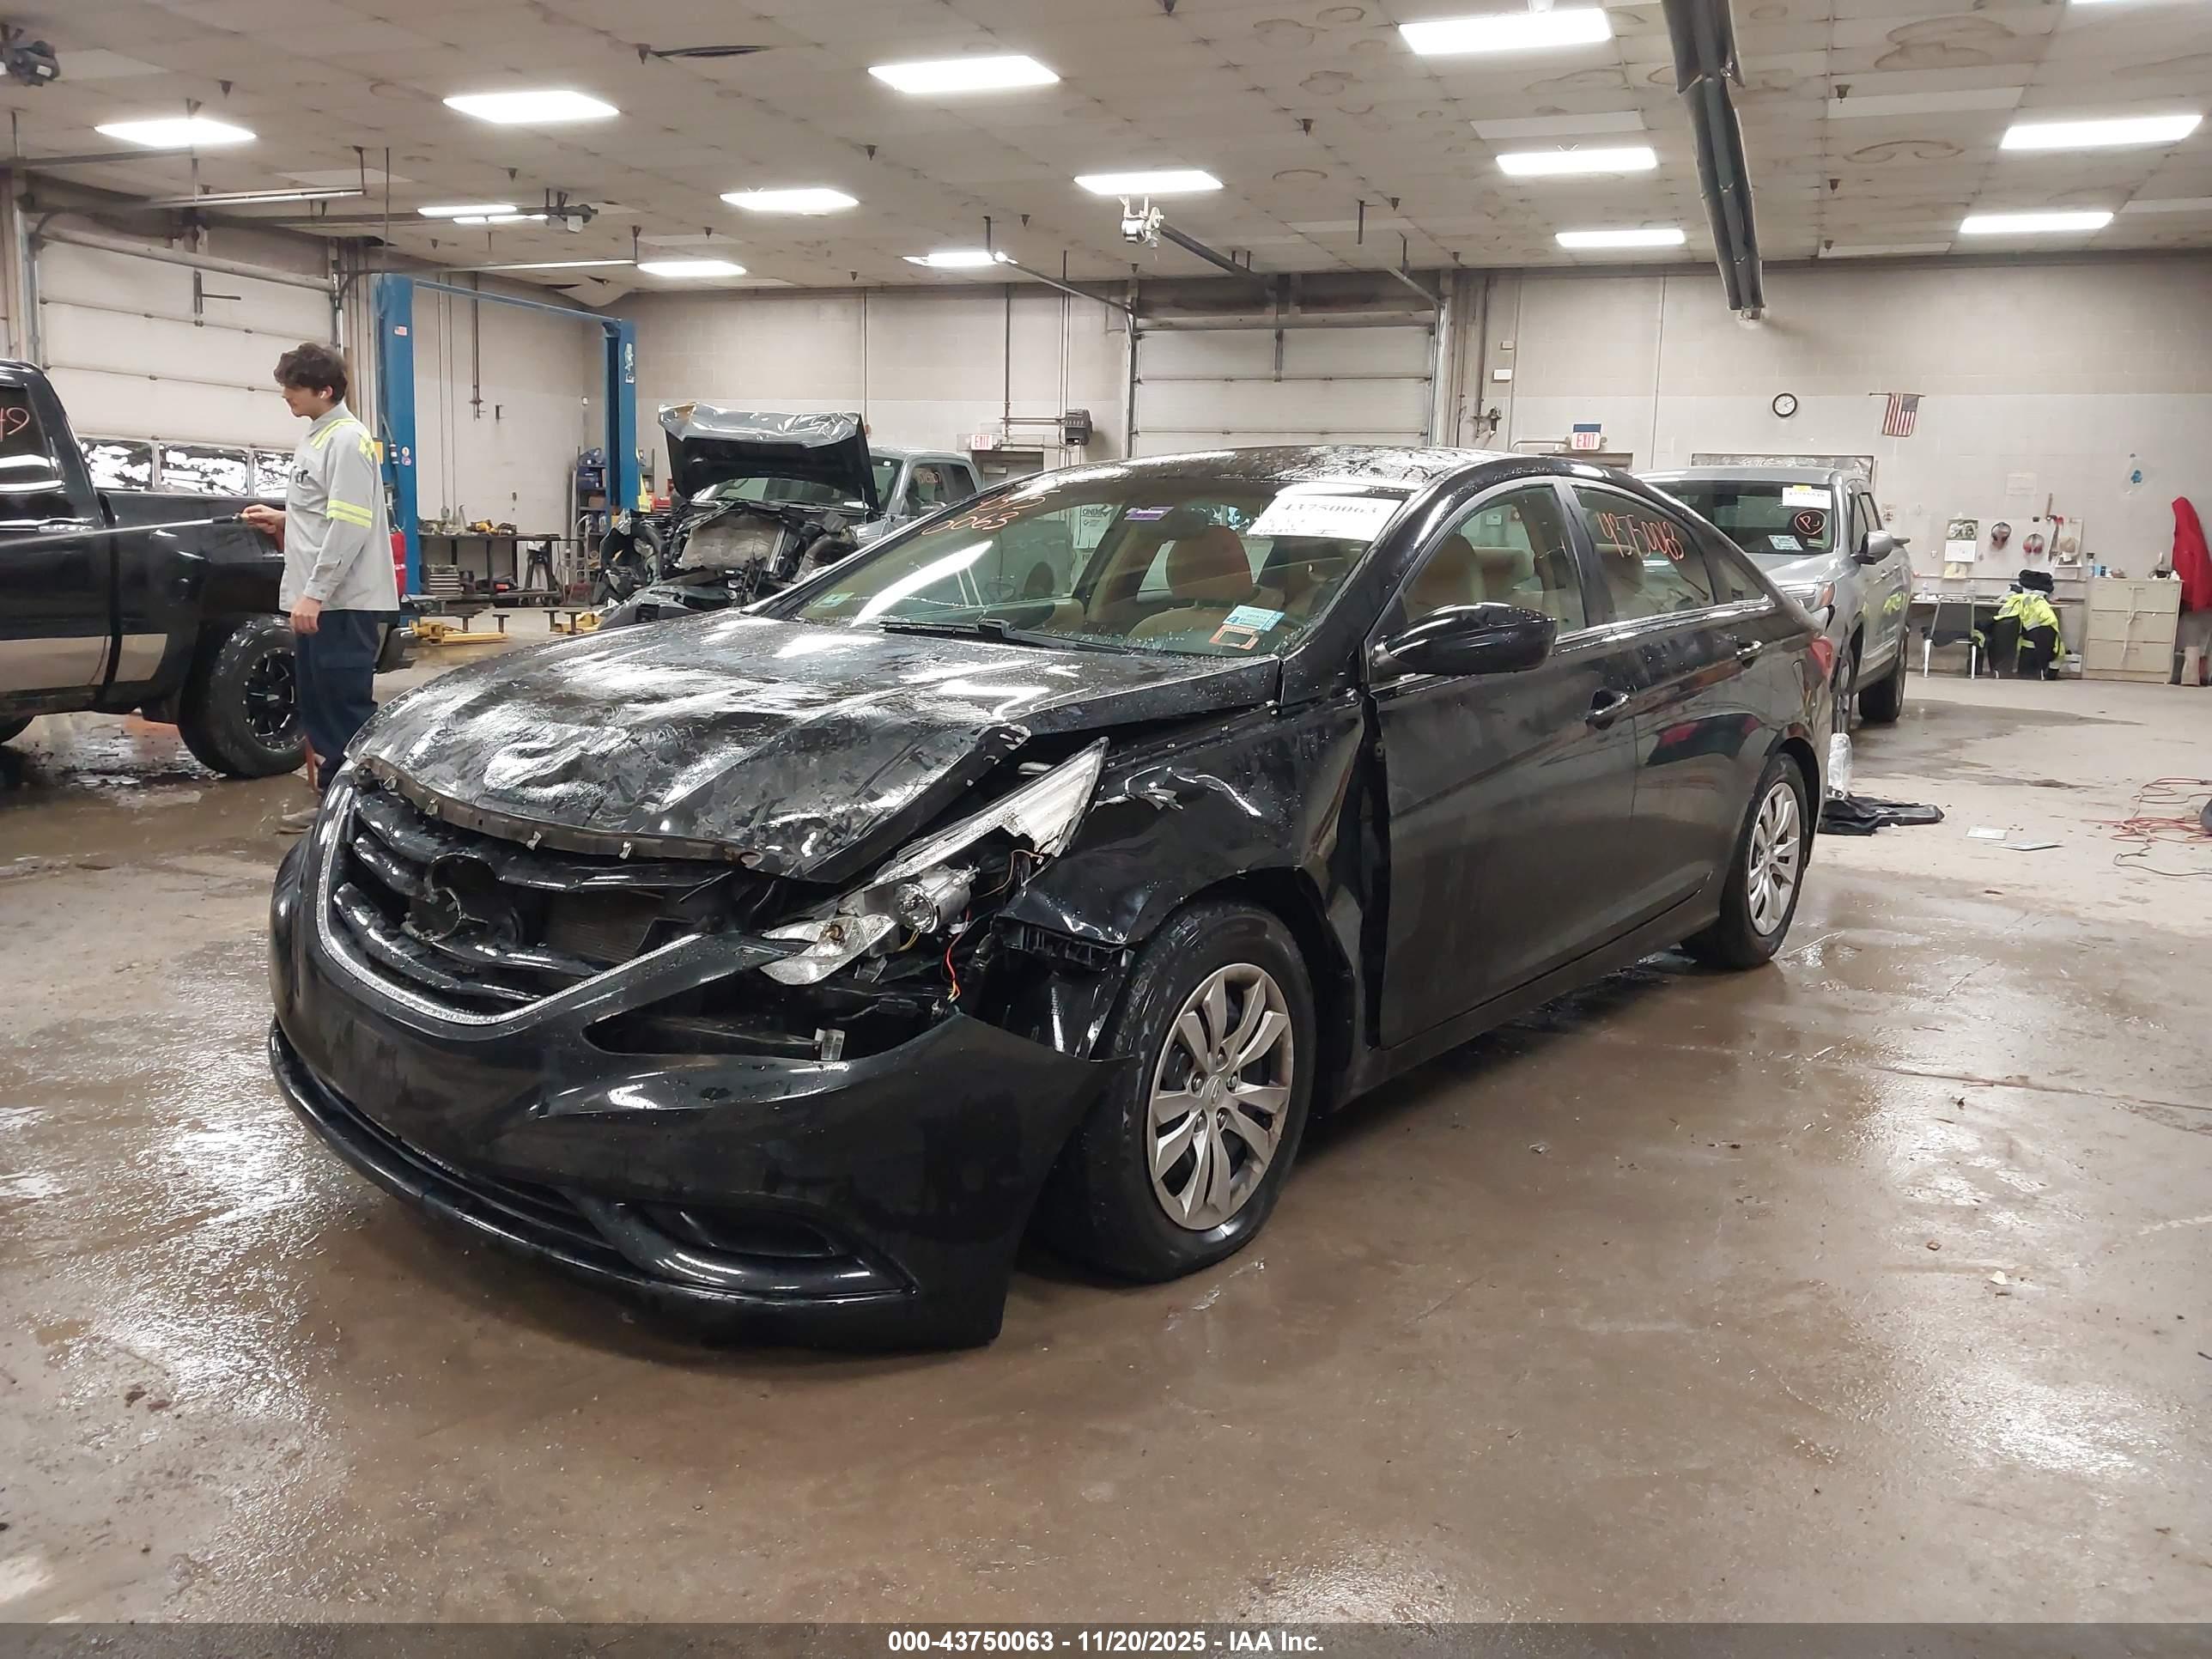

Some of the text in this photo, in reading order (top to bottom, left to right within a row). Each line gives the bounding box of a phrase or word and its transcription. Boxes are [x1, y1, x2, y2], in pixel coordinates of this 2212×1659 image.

[975, 435, 989, 447] EXIT
[1577, 434, 1596, 447] EXIT
[921, 511, 1019, 536] 0063
